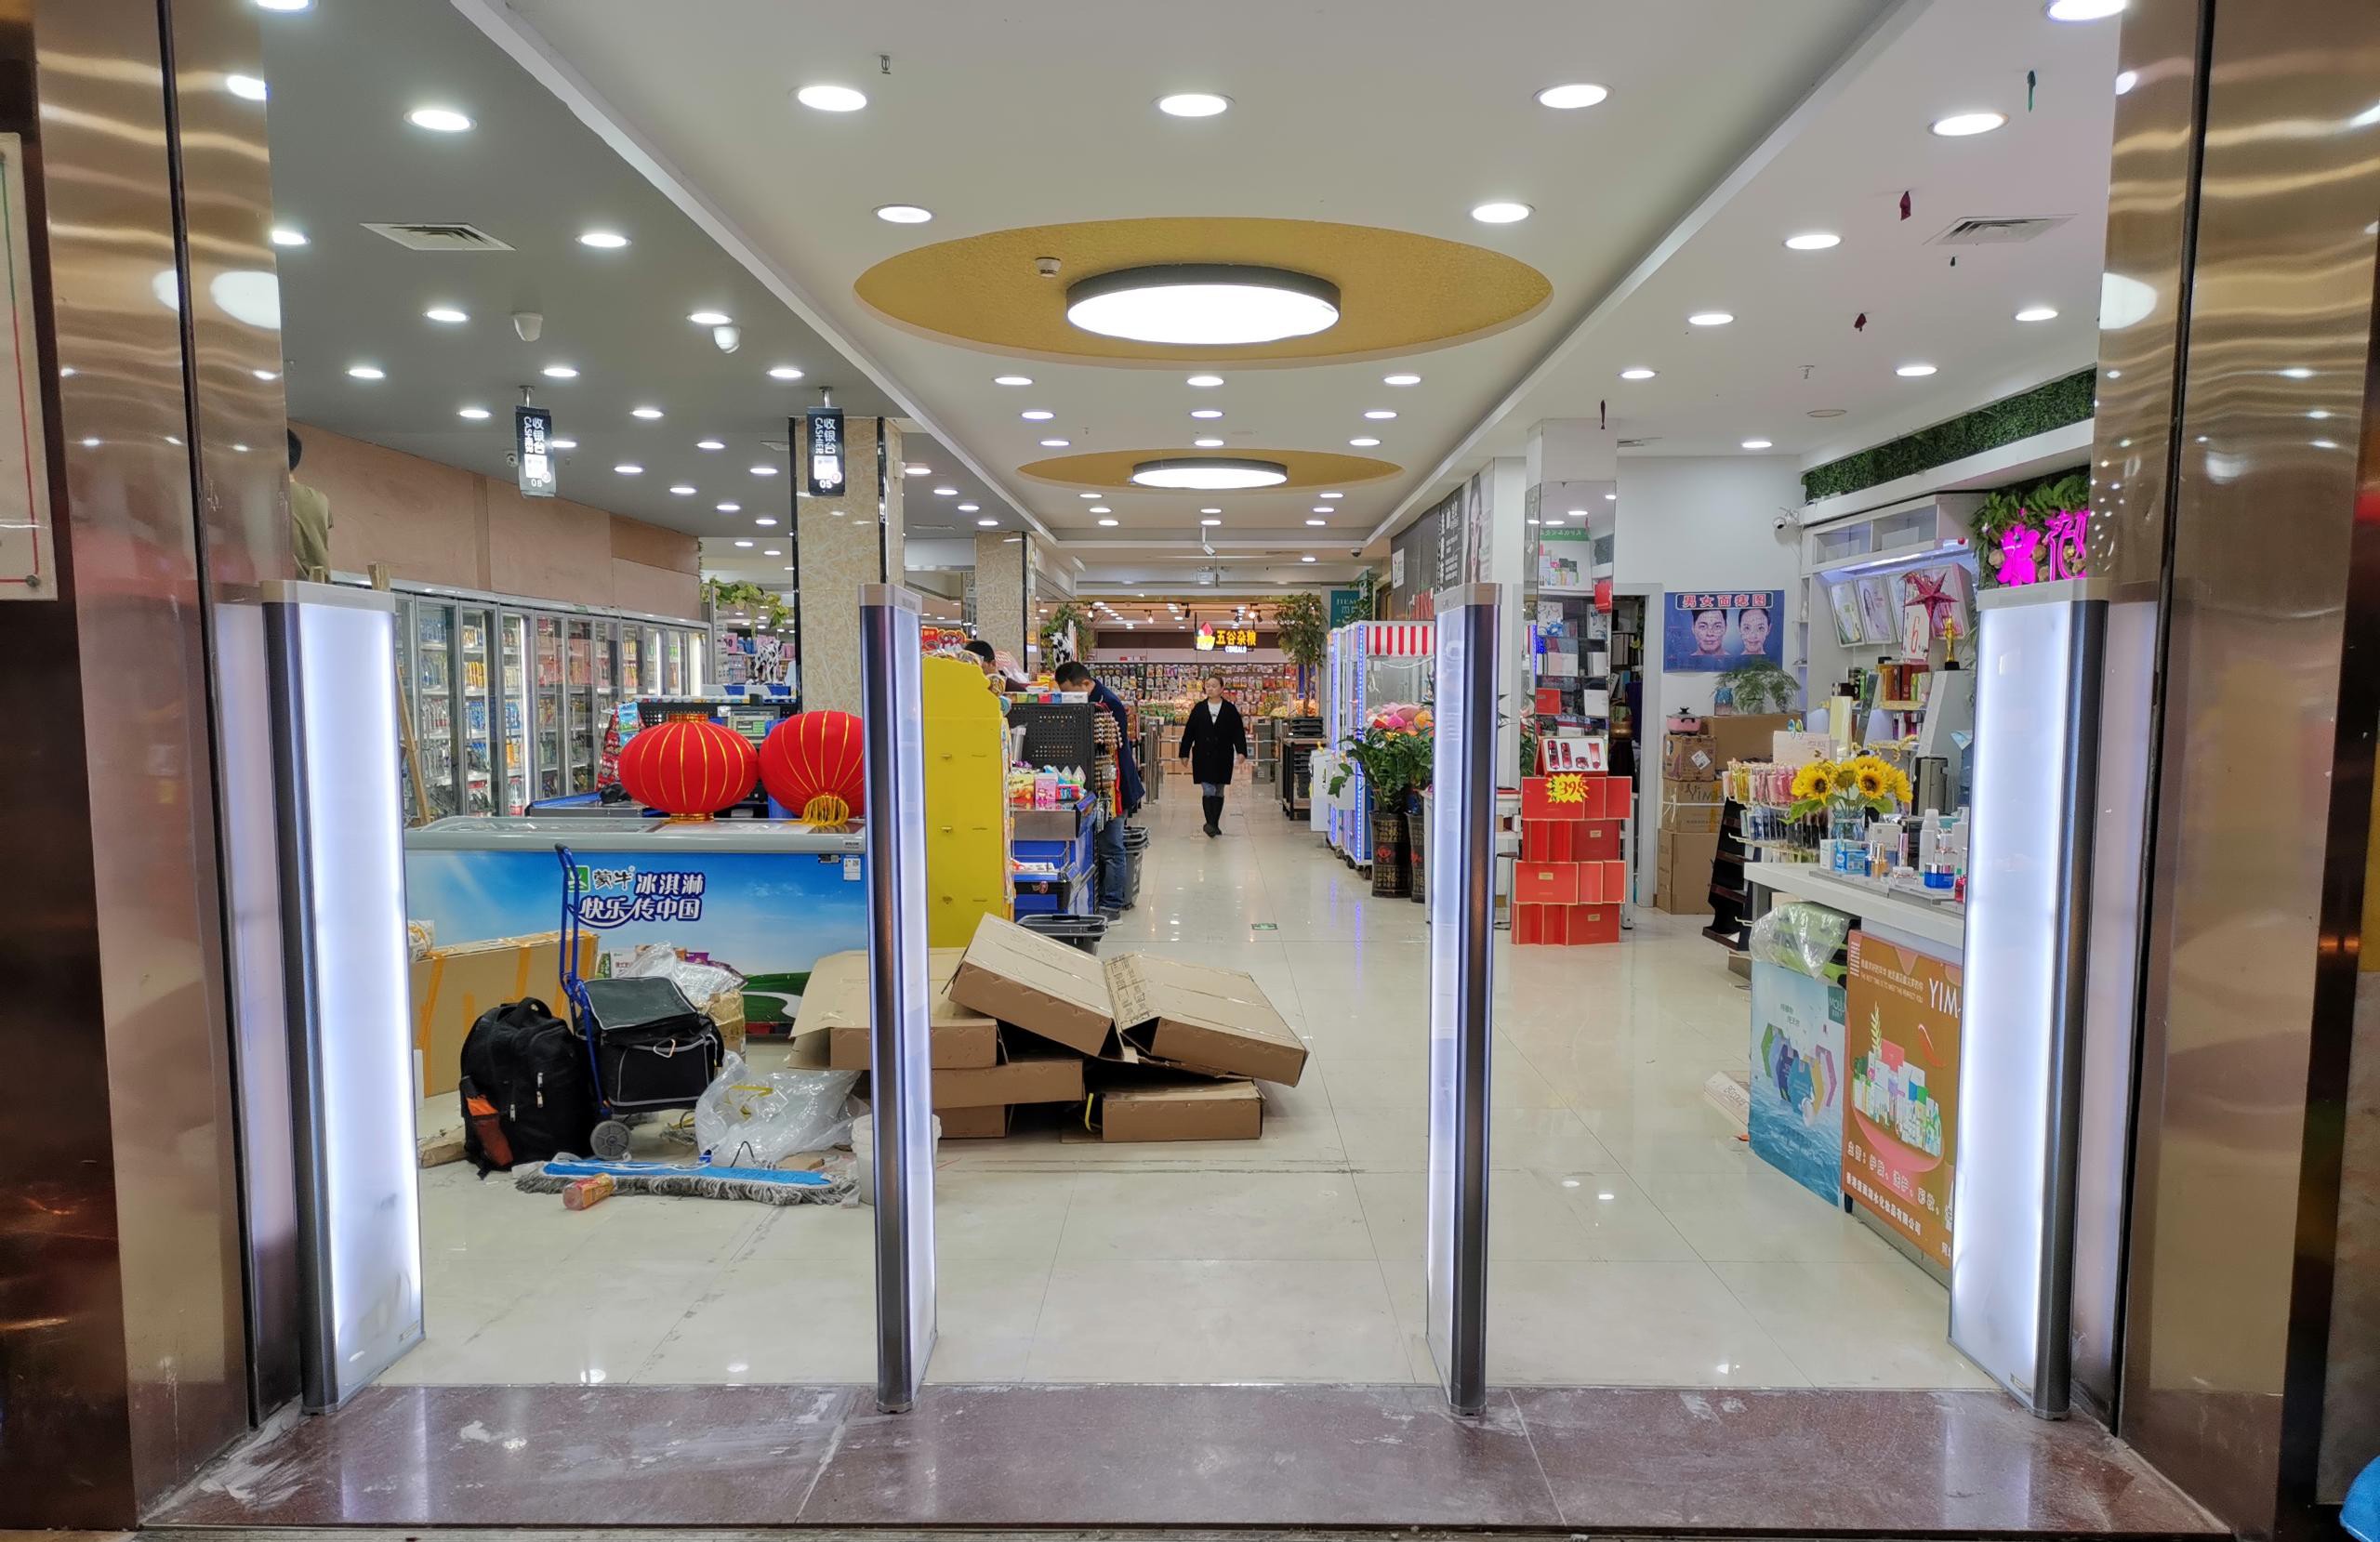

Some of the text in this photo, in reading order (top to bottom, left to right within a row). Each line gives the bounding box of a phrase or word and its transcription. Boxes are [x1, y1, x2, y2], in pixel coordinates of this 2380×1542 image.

[523, 415, 534, 454] CASHIER
[533, 416, 545, 455] 收银台
[814, 416, 825, 455] CASHIER
[824, 417, 836, 455] 收银台
[819, 480, 833, 489] 05
[1683, 594, 1766, 608] 男女面痣图
[1216, 629, 1257, 646] 五谷杂粮
[592, 868, 706, 896] 蒙牛 冰淇淋
[577, 895, 702, 928] 快乐传中国
